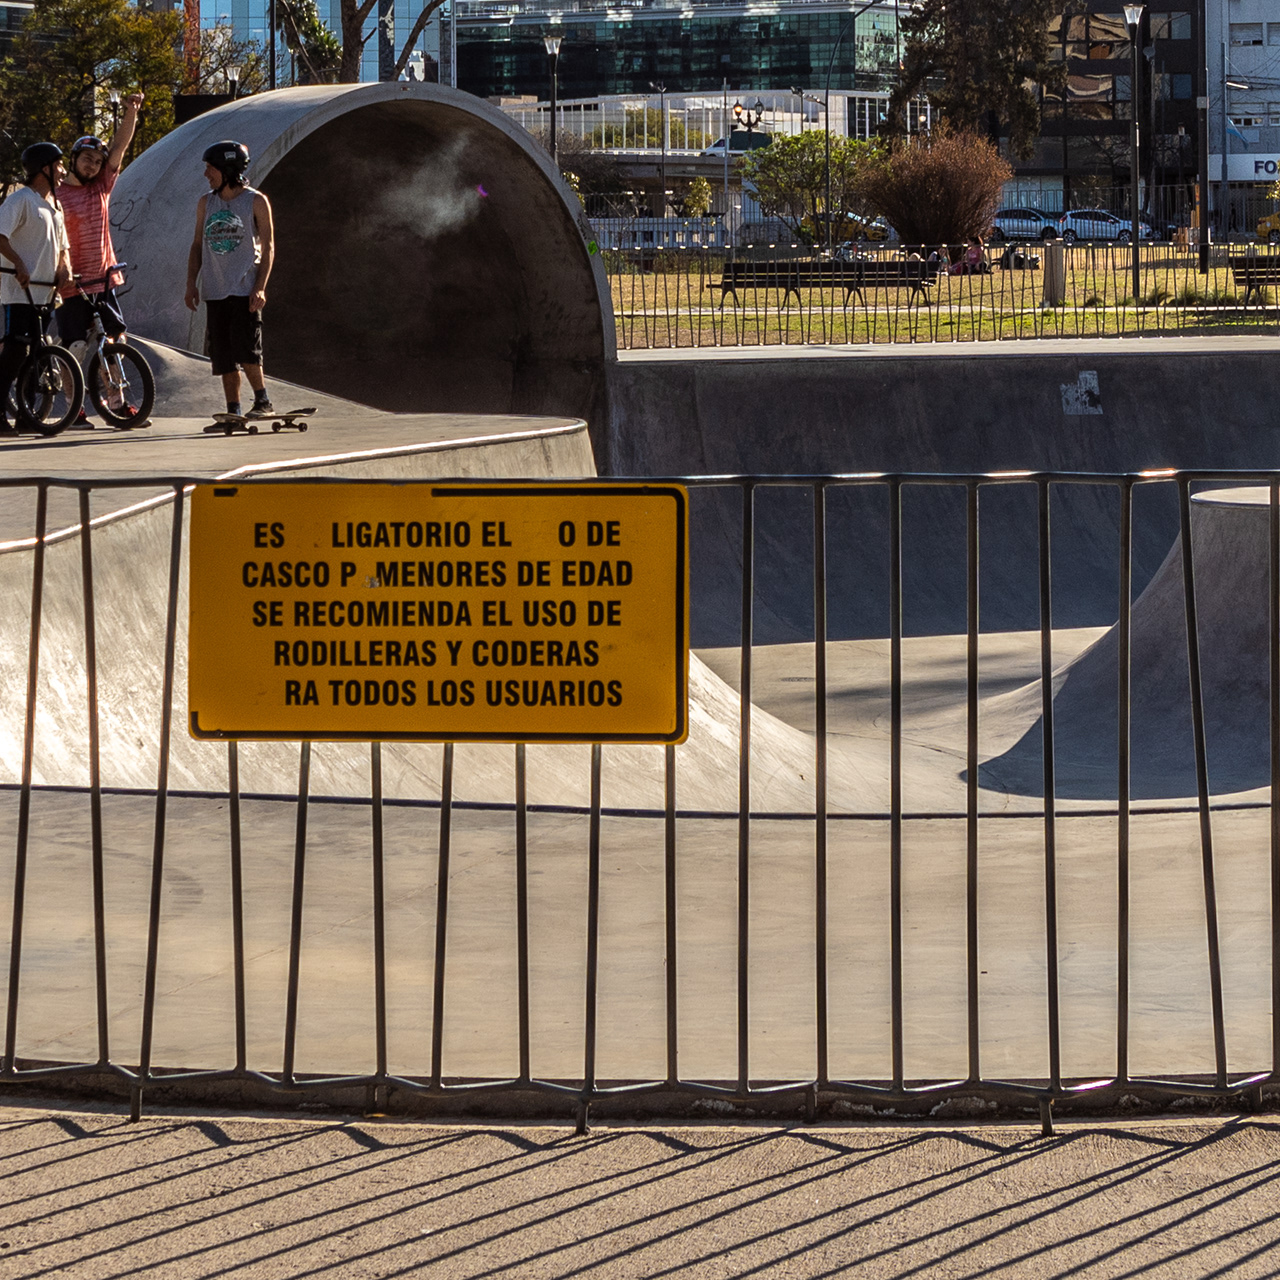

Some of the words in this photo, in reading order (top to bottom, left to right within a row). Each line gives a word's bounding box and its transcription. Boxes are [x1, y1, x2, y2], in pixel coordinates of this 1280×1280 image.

[254, 521, 285, 549] ES
[331, 520, 471, 548] LIGATORIO
[481, 521, 513, 548] EL
[586, 520, 621, 547] DE
[242, 561, 330, 588] CASCO
[375, 560, 507, 588] MENORES
[517, 560, 551, 587] DE
[562, 560, 633, 587] EDAD
[252, 600, 284, 628] SE
[293, 600, 472, 628] RECOMIENDA
[482, 600, 513, 627] EL
[522, 599, 577, 627] USO
[587, 600, 622, 627] DE
[274, 639, 437, 667] RODILLERAS
[445, 640, 463, 667] Y
[472, 639, 599, 667] CODERAS
[285, 679, 320, 706] RA
[328, 679, 417, 707] TODOS
[427, 679, 475, 707] LOS
[485, 679, 623, 707] USUARIOS
